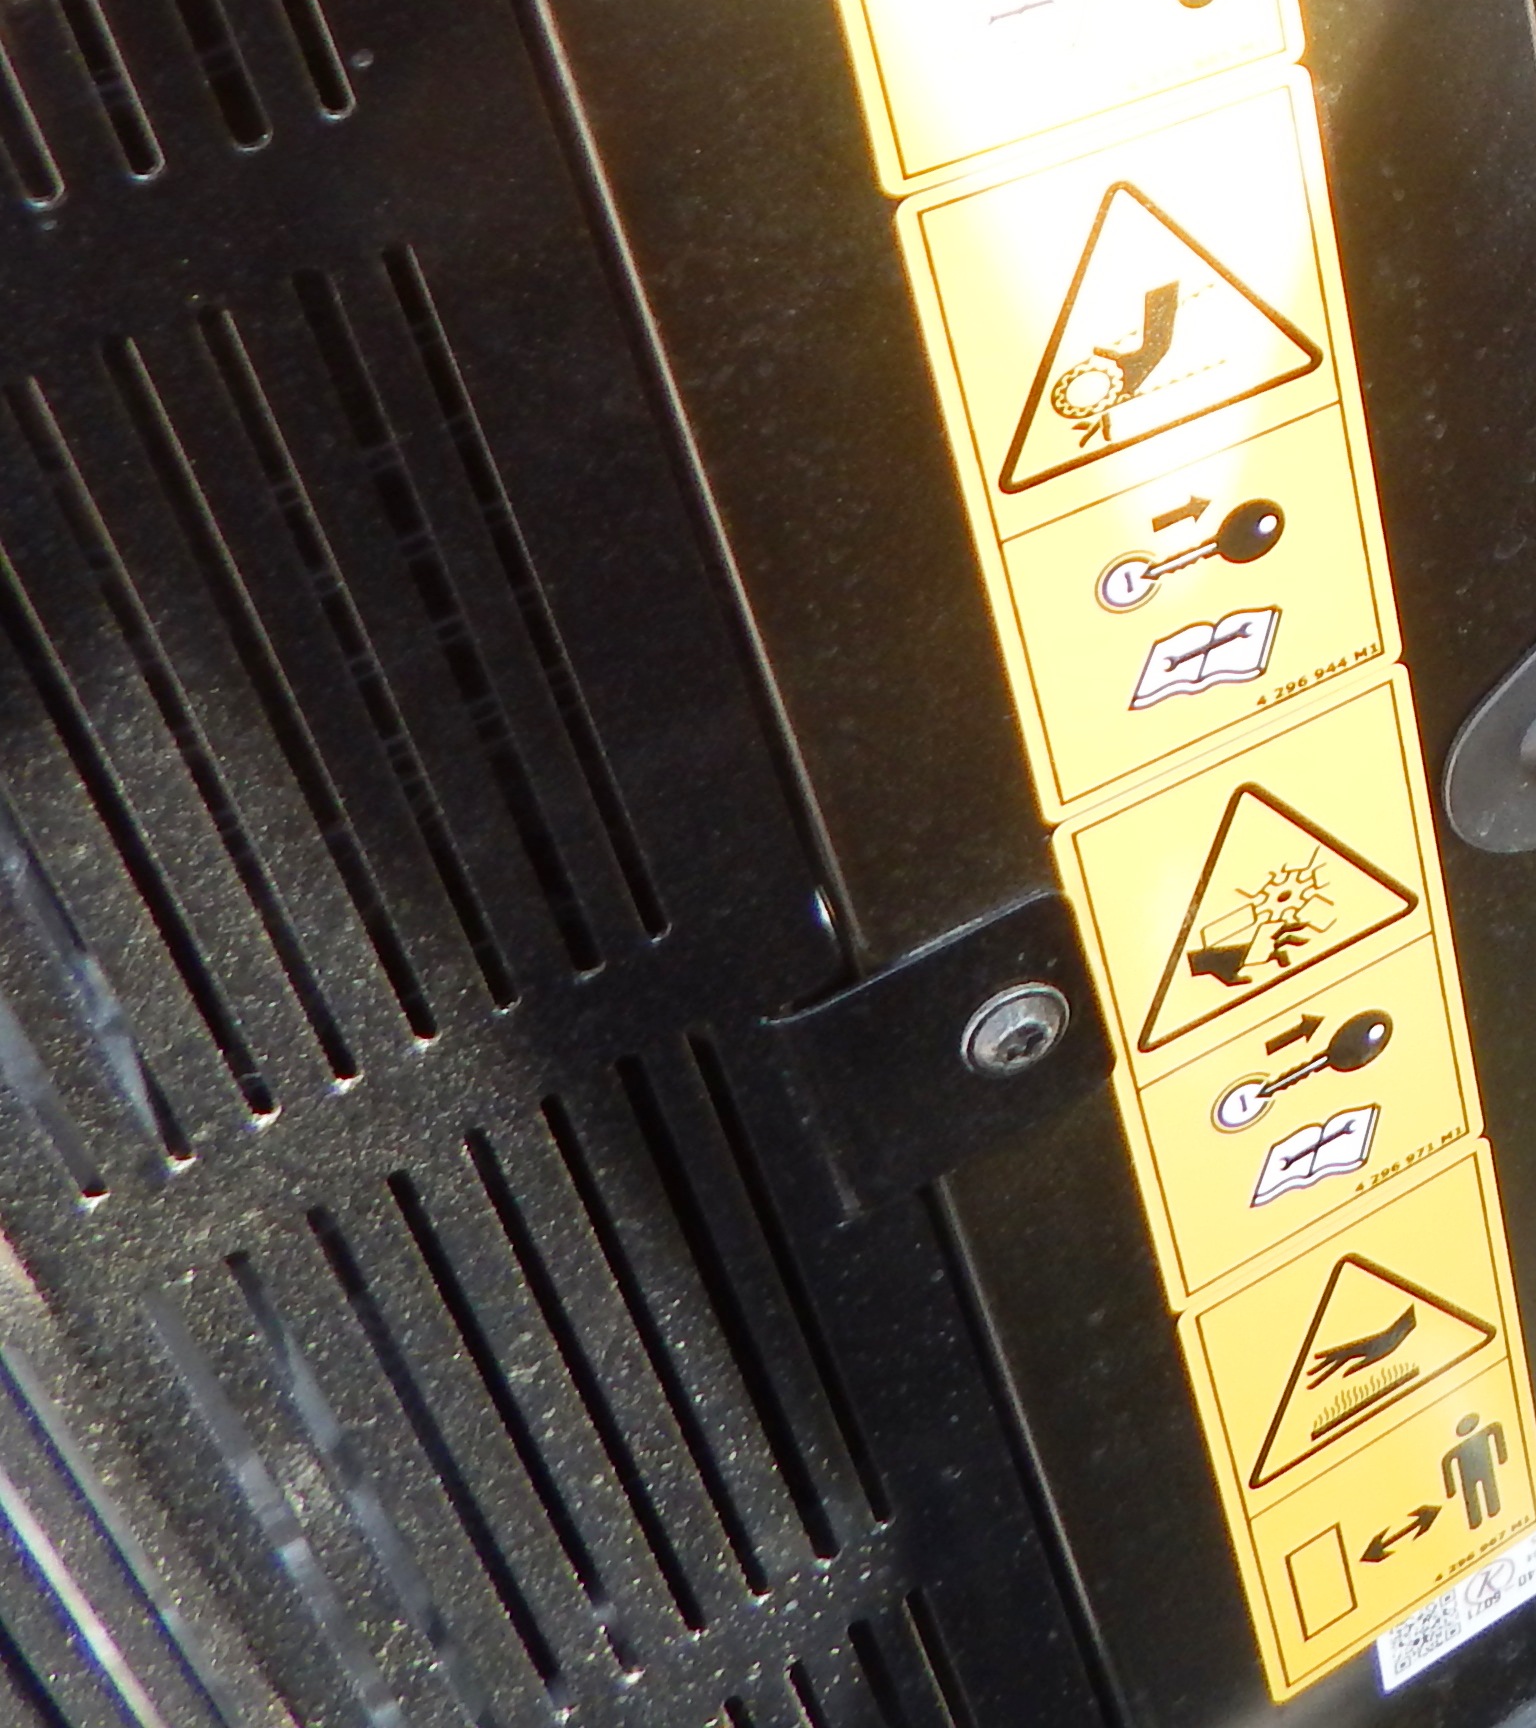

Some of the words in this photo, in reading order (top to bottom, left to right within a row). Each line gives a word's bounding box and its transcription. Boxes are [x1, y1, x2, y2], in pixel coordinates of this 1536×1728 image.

[1274, 676, 1308, 700] 296
[1314, 657, 1348, 680] 944
[1354, 642, 1379, 661] M1
[1370, 1161, 1400, 1185] 296
[1440, 1126, 1462, 1144] M1
